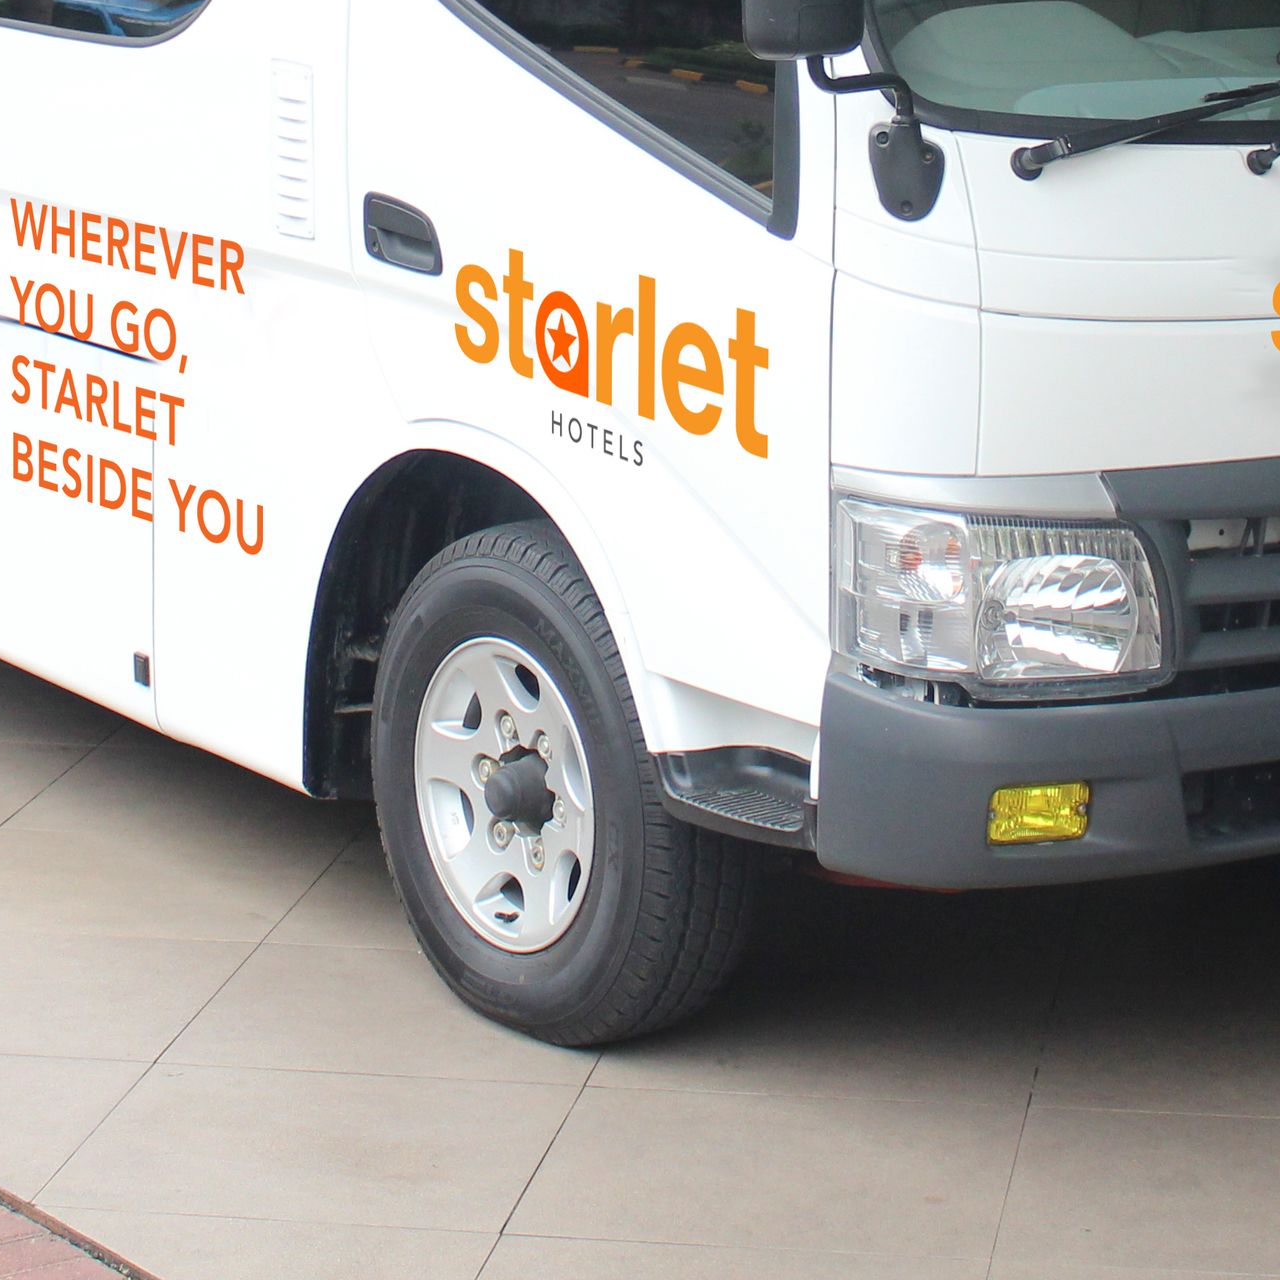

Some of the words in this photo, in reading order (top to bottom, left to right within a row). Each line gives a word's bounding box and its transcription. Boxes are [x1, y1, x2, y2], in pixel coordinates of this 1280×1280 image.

[10, 197, 246, 295] WHEREVER
[10, 275, 94, 342] YOU
[110, 300, 189, 374] GO,
[454, 248, 769, 459] starlet
[10, 354, 186, 446] STARLET
[551, 409, 645, 467] HOTELS
[11, 431, 154, 523] BESIDE
[168, 477, 265, 556] YOU
